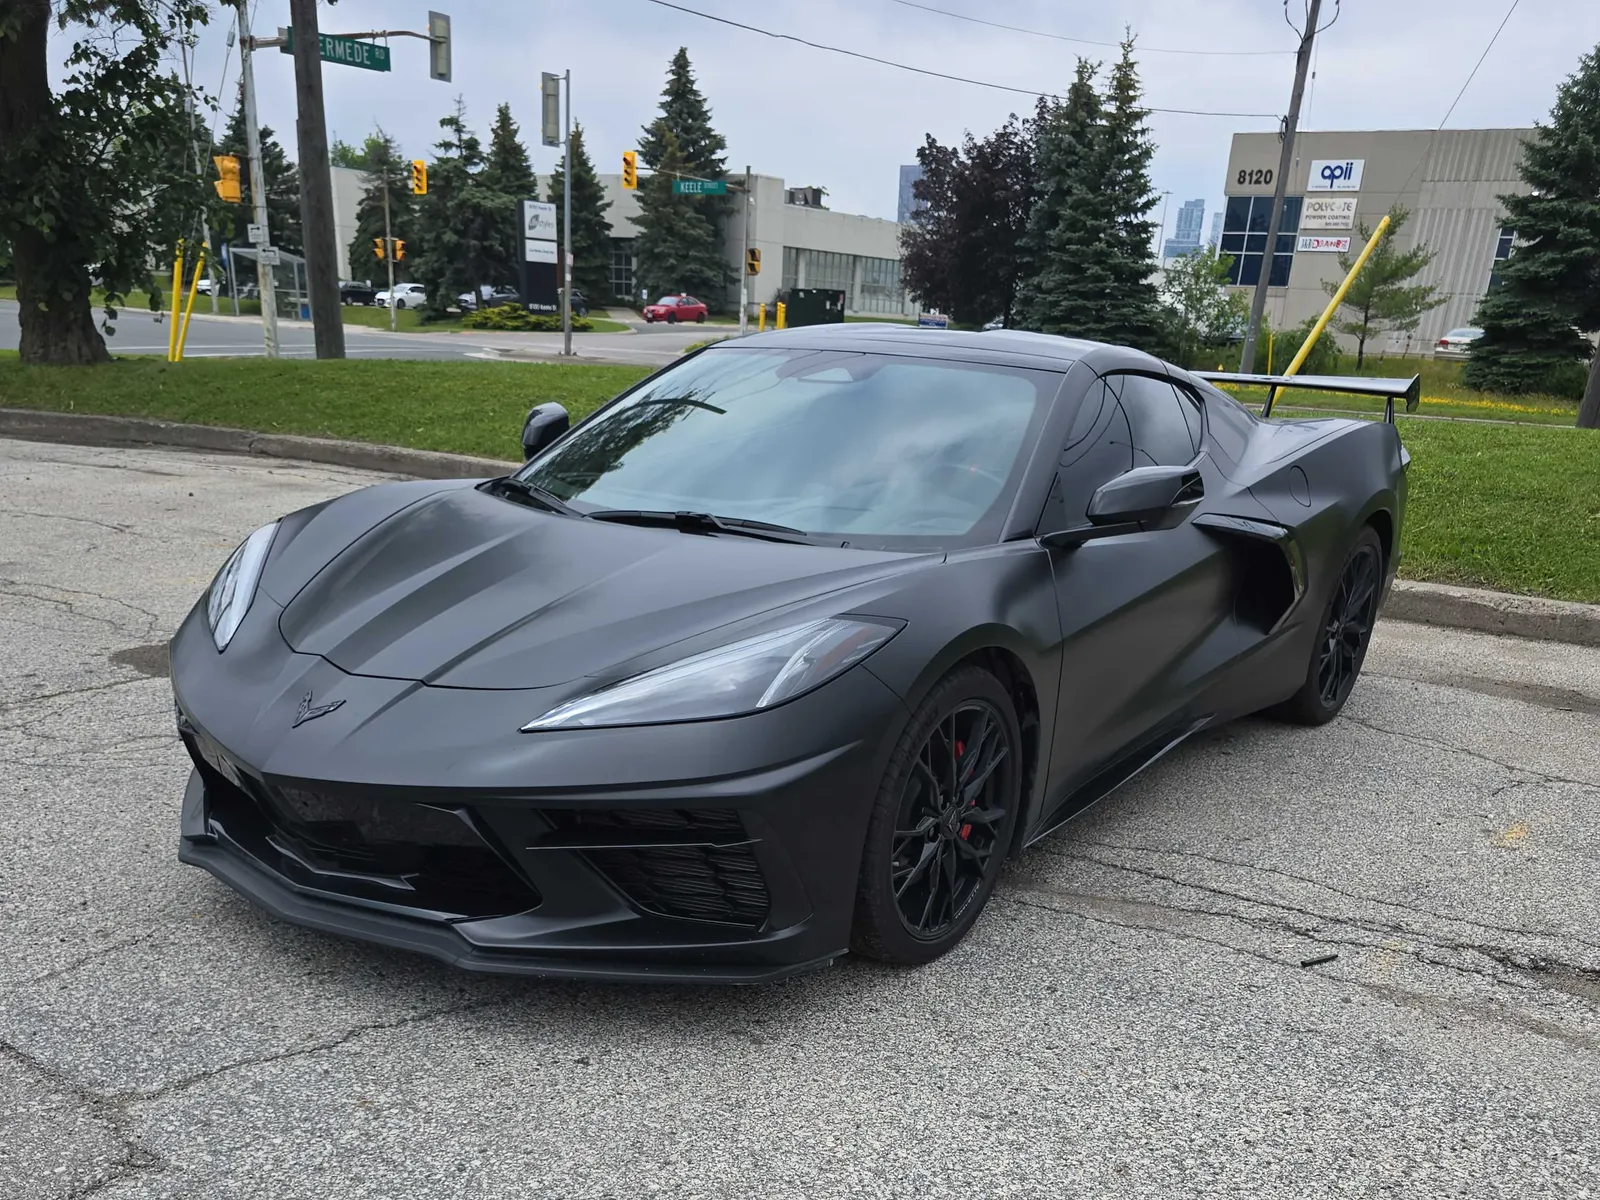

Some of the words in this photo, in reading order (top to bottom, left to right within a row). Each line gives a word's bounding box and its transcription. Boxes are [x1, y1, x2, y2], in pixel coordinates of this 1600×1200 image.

[319, 36, 371, 65] ERMEDE
[375, 47, 385, 59] RD
[1237, 169, 1273, 185] 8120
[680, 182, 702, 193] KEELE
[1306, 201, 1353, 212] POLYCTE
